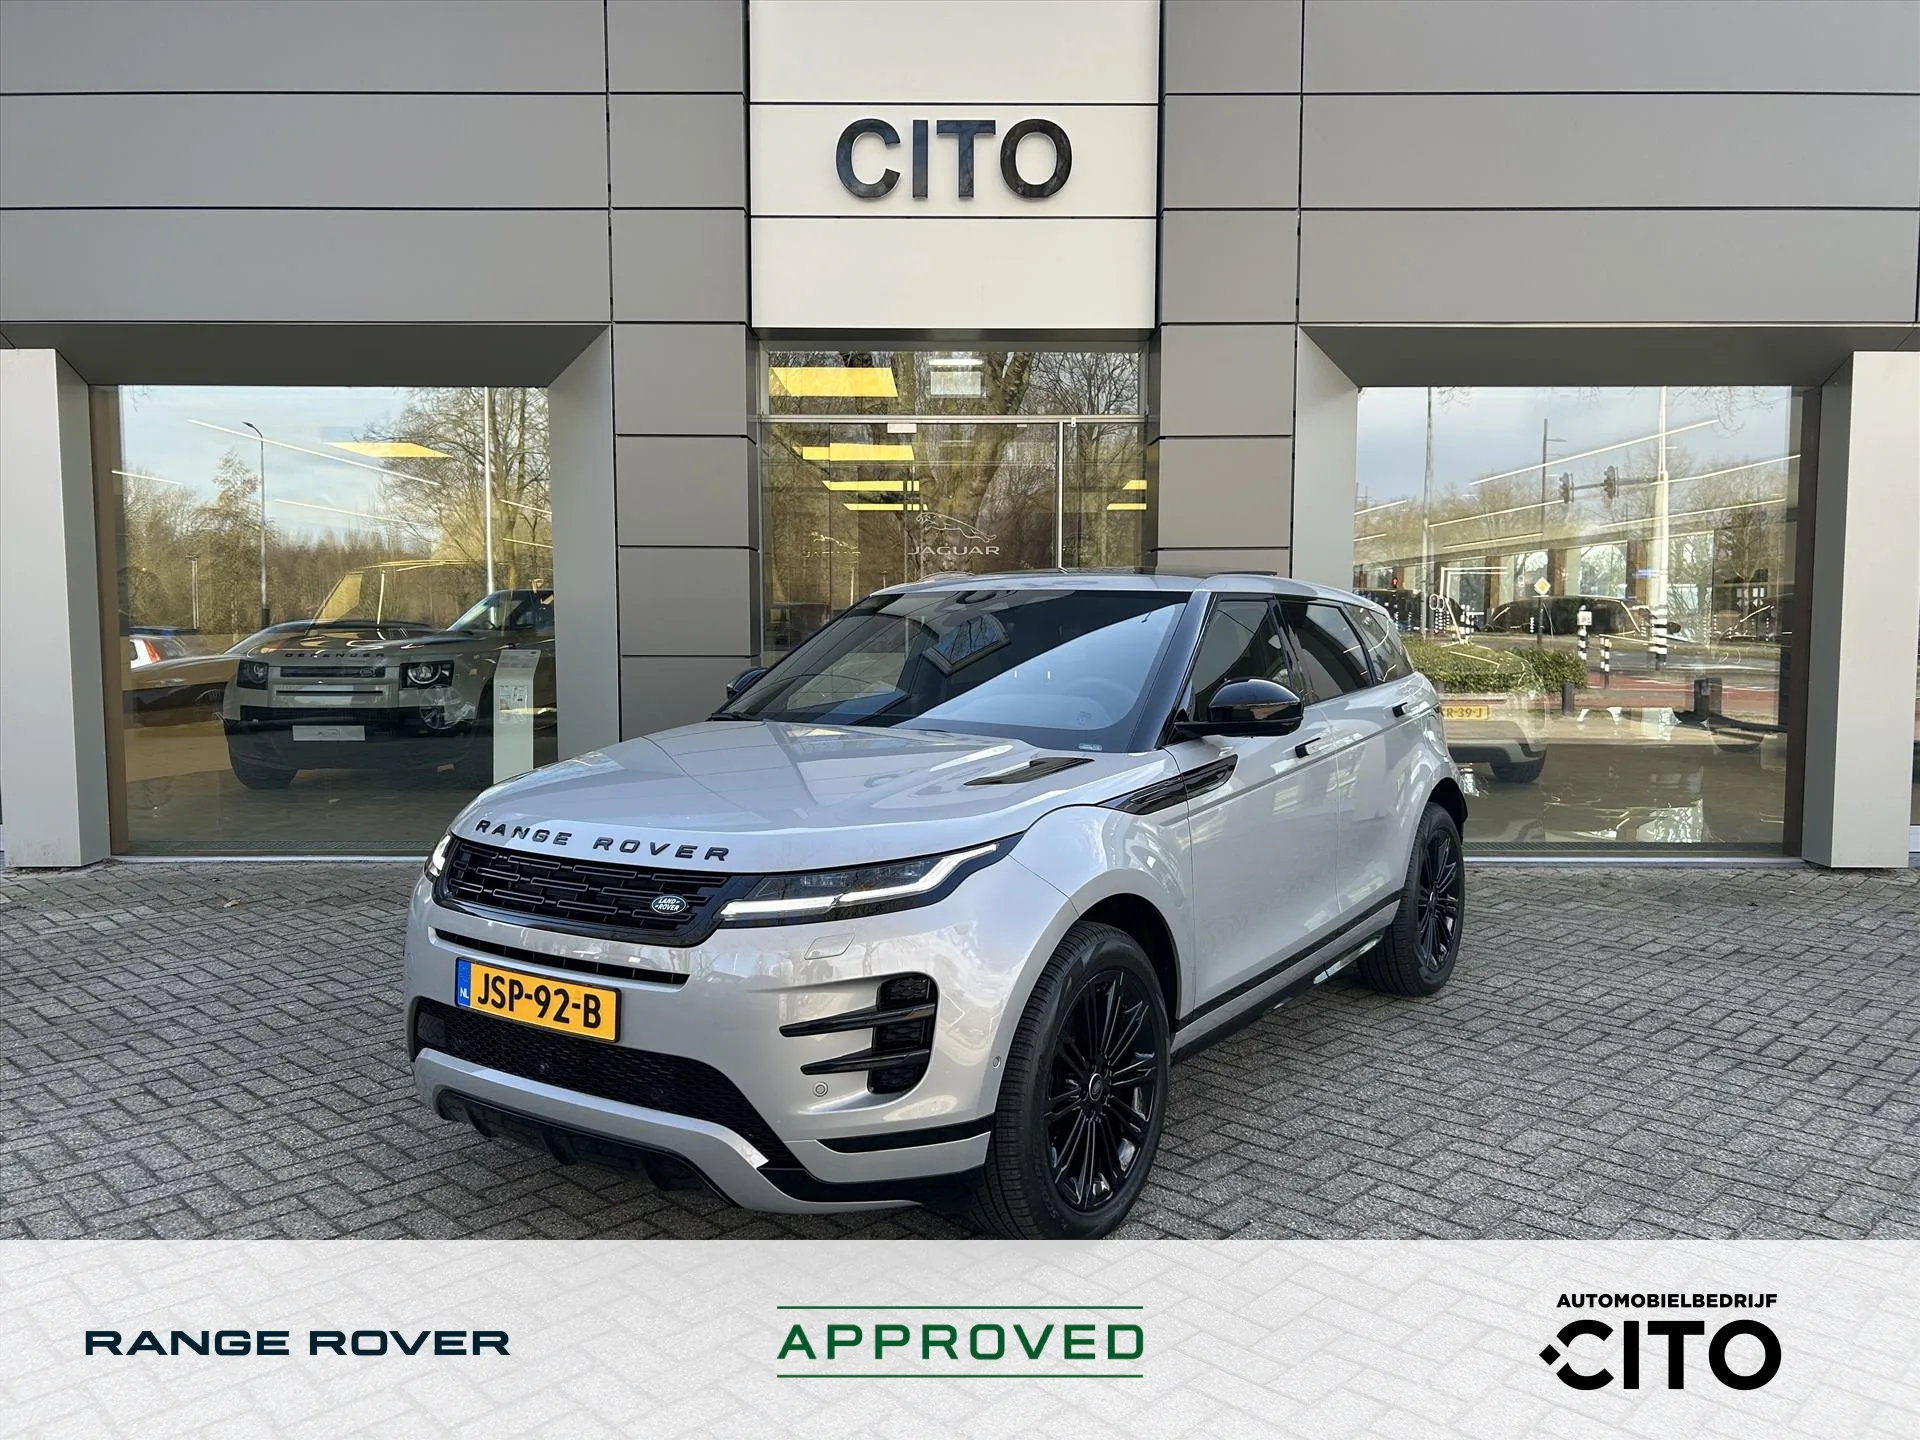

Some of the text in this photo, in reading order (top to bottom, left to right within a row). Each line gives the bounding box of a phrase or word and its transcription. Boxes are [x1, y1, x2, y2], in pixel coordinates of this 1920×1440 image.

[836, 119, 1073, 201] CITO
[907, 546, 1000, 556] JAGUAR
[475, 819, 730, 862] RANGE ROVER
[657, 903, 680, 911] ROVER
[459, 986, 470, 999] NL
[477, 973, 602, 1029] JSP-92-B
